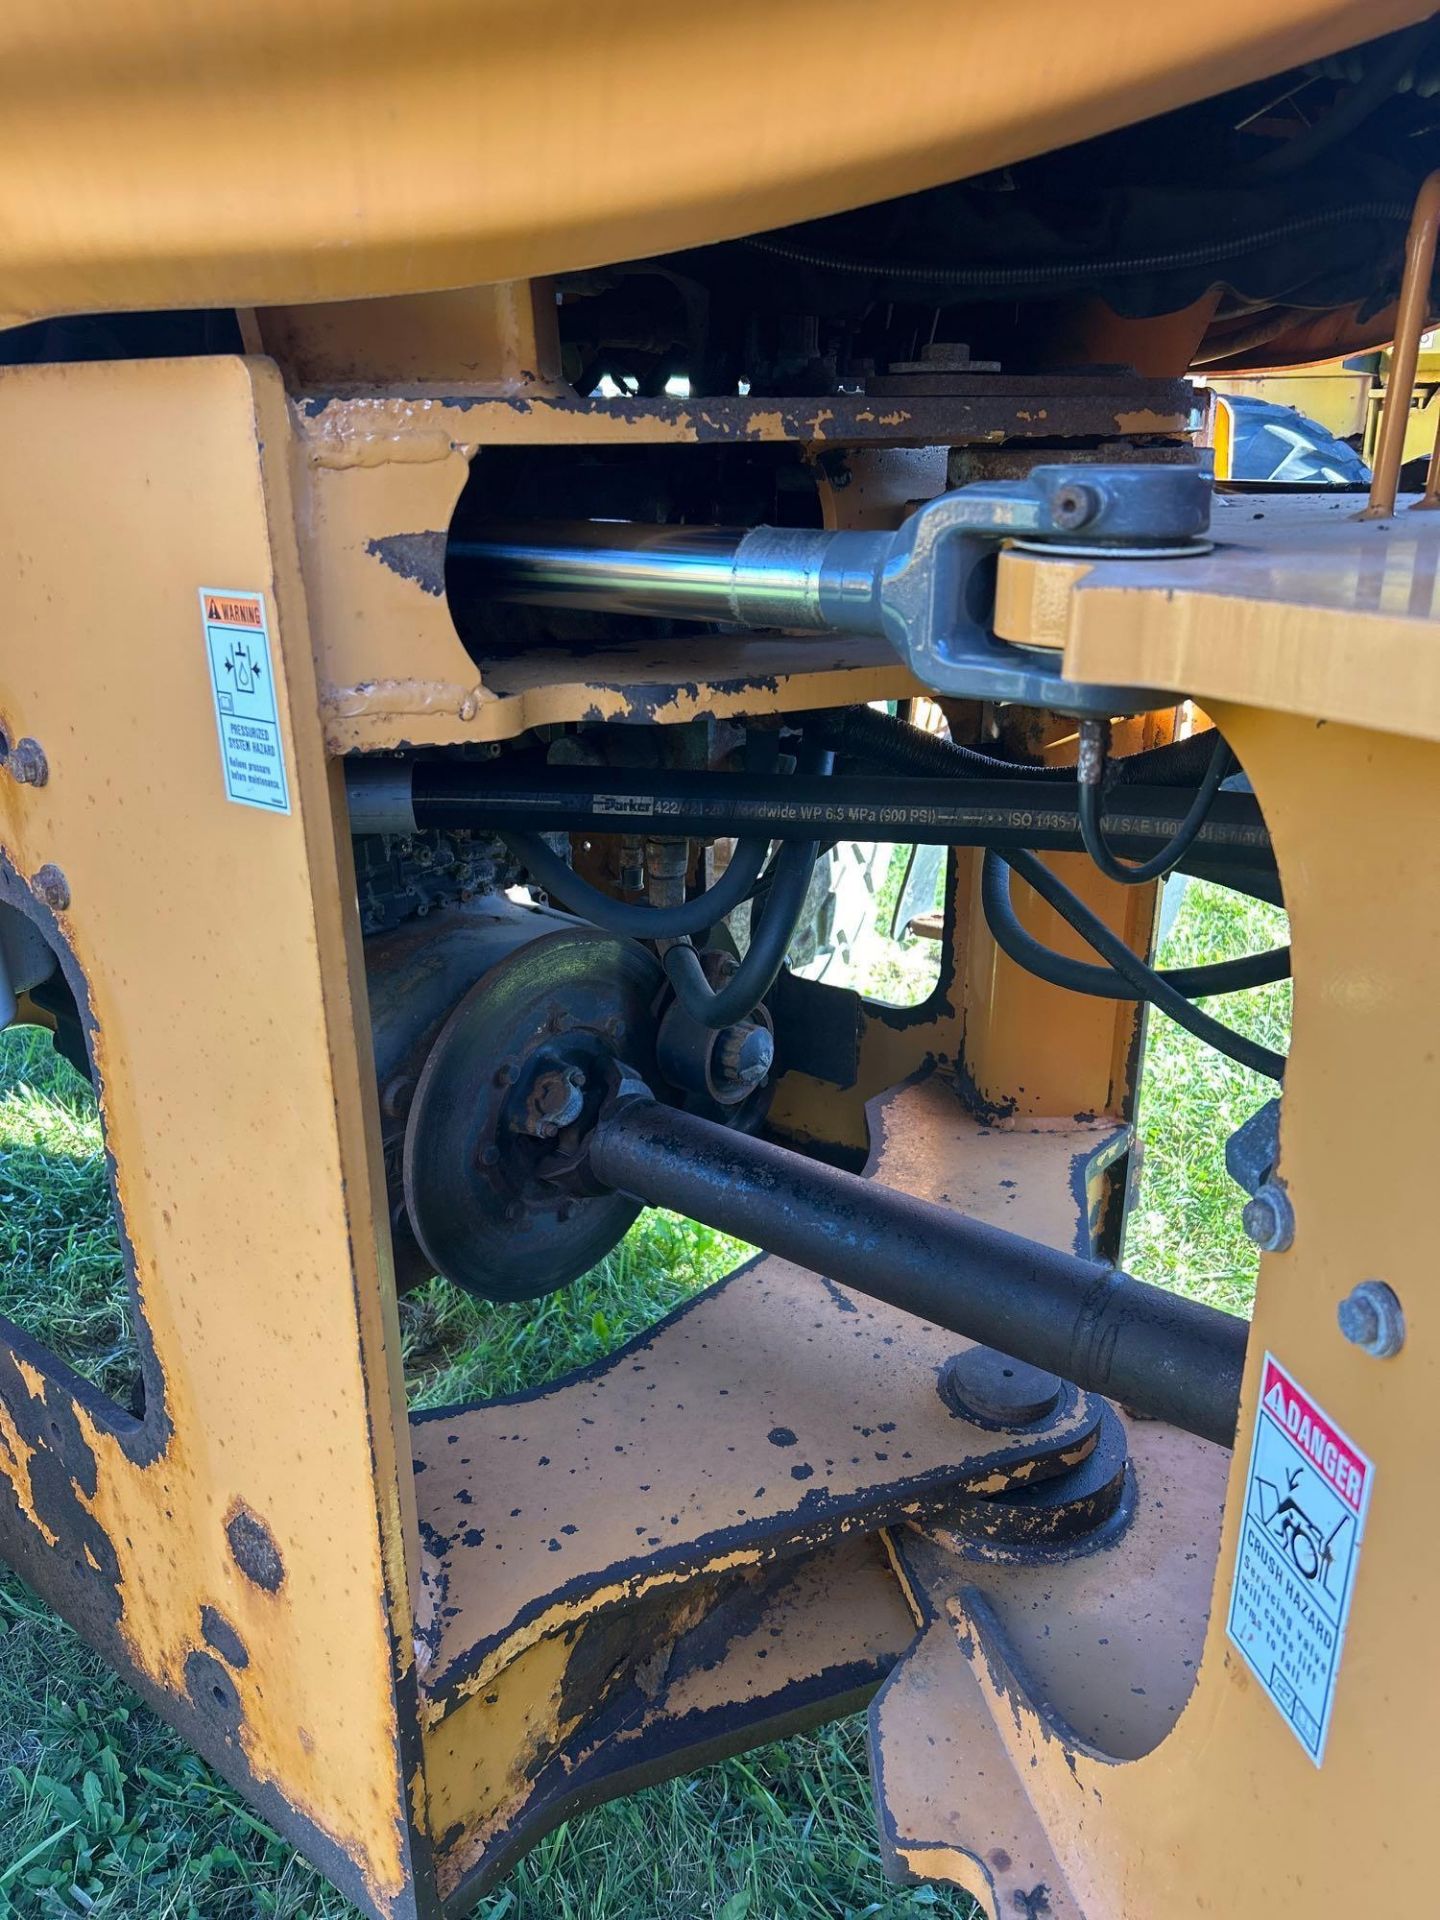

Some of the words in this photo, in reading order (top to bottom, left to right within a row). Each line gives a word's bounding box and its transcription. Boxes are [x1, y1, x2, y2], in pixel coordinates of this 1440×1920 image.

[221, 604, 261, 624] WARNING
[228, 737, 251, 752] SYSTEM
[252, 742, 275, 757] HAZARD
[230, 723, 269, 741] PRESSURIZED
[602, 798, 652, 811] Parker
[801, 806, 822, 819] WP
[826, 807, 844, 820] 6.3
[848, 807, 876, 821] MPa
[880, 808, 906, 822] (900
[910, 809, 936, 824] PSI)
[1008, 812, 1032, 826] ISO
[1121, 818, 1150, 833] SAE
[1286, 1400, 1362, 1506] DANGER
[1241, 1575, 1261, 1607] will
[1264, 1607, 1294, 1653] cause
[1299, 1650, 1317, 1685] lift
[1244, 1555, 1292, 1631] Servicing
[1297, 1629, 1327, 1674] valve
[1247, 1529, 1283, 1586] CRUSH
[1285, 1579, 1332, 1650] HAZARD
[1239, 1594, 1262, 1632] arms
[1266, 1631, 1276, 1651] to
[1281, 1649, 1303, 1690] fall.
